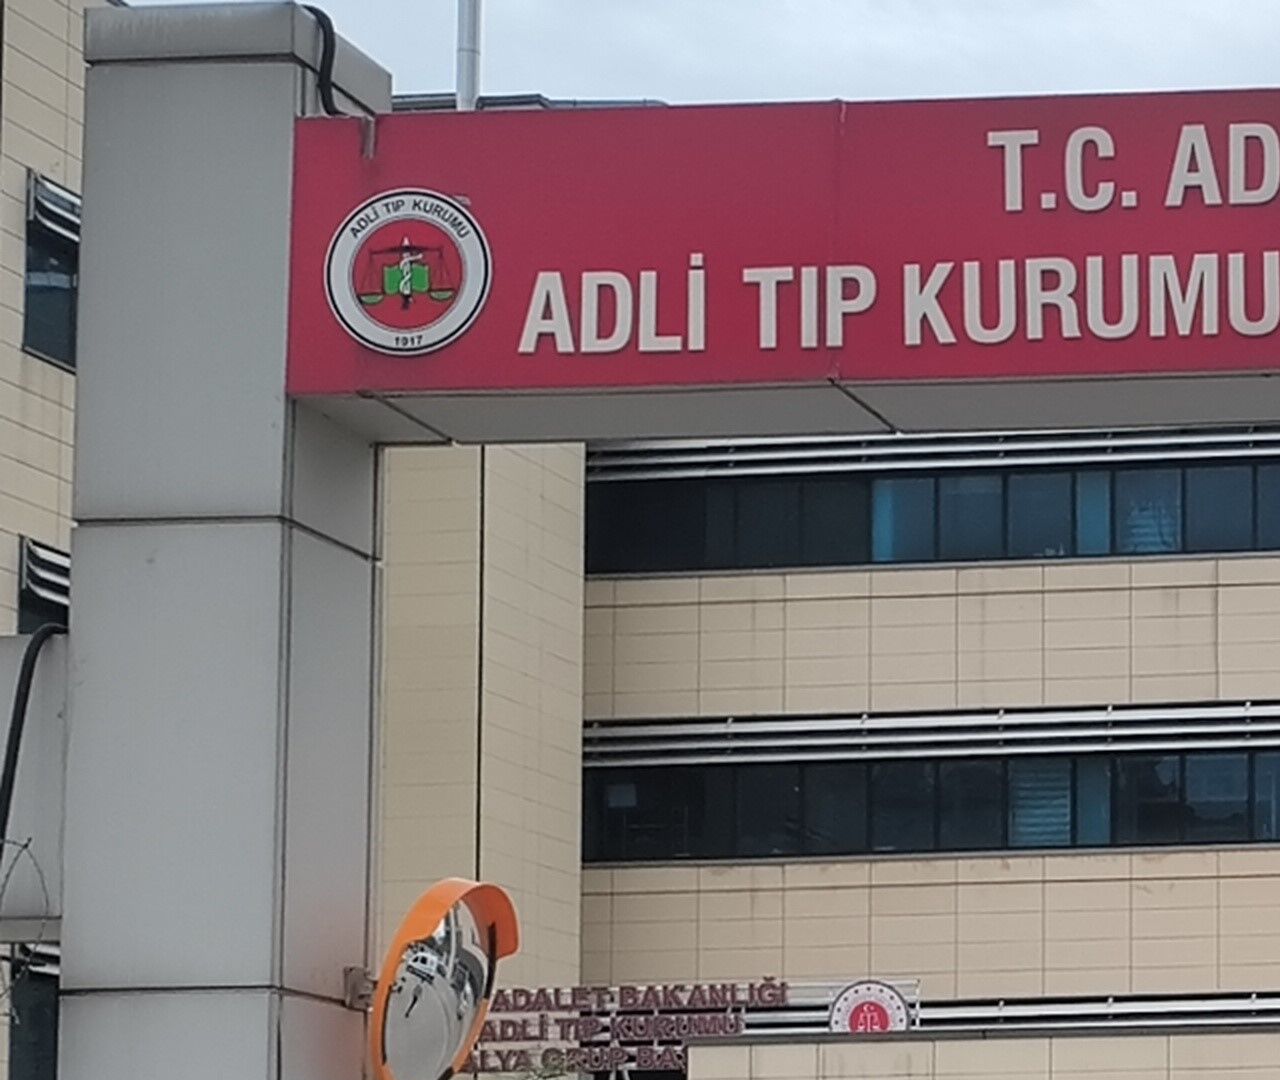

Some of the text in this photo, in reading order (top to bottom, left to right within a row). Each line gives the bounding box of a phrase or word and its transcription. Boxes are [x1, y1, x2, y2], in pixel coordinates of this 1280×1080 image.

[987, 126, 1138, 212] T.C.
[350, 199, 471, 239] ADLİ TIP KURUMU
[517, 253, 707, 354] ADLİ
[742, 264, 878, 350] TIP
[394, 335, 424, 346] 1917
[490, 976, 788, 1012] ADALET BAKANLIĞI
[479, 1014, 743, 1042] ADLİ TIP KURUMU
[541, 1047, 628, 1073] GRUP
